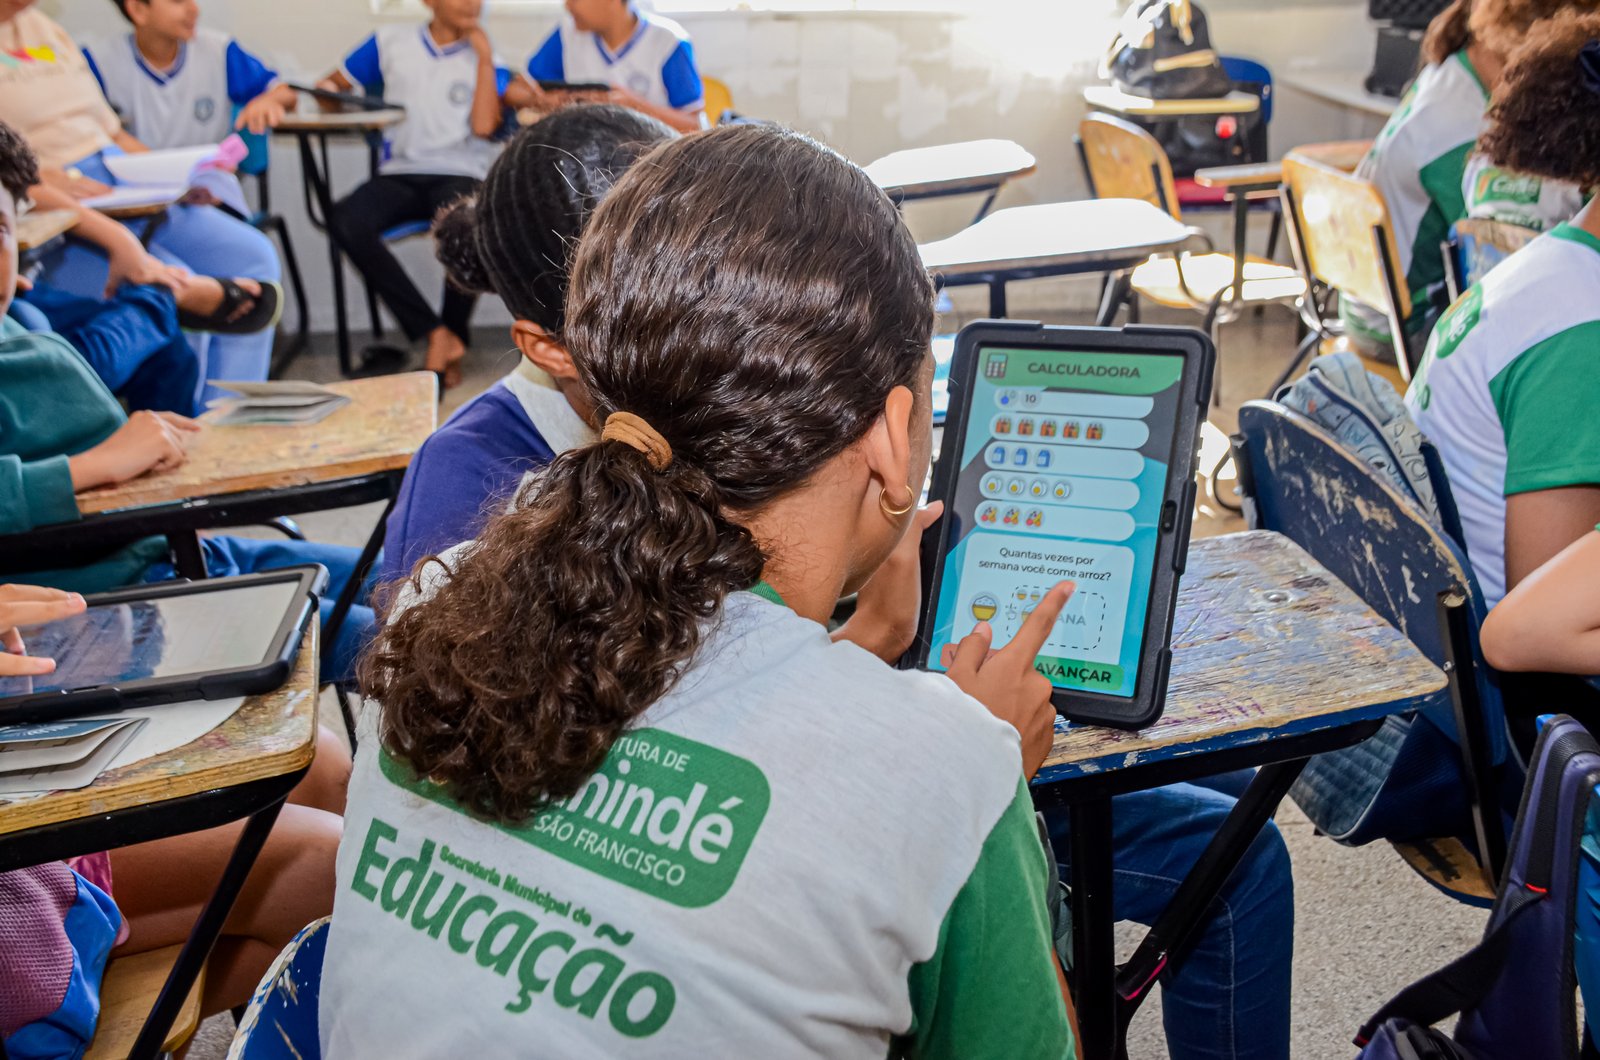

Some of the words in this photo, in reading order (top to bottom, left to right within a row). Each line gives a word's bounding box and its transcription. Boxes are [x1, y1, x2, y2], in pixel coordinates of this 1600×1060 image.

[1027, 362, 1141, 378] CALCULADORA
[999, 547, 1042, 560] Quantas
[1044, 554, 1074, 563] vezes
[1075, 556, 1095, 566] por
[978, 559, 1019, 571] semana
[1021, 564, 1045, 574] você
[1047, 567, 1077, 578] come
[1078, 571, 1112, 581] arroz?
[1035, 662, 1112, 684] AVANÇAR
[662, 750, 691, 772] DE
[560, 759, 744, 865] nindé
[534, 814, 575, 842] SÃO
[573, 828, 686, 887] FRANCISCO
[440, 845, 501, 888] Secretaria
[502, 873, 572, 918] Municipal
[572, 906, 592, 927] de
[350, 817, 677, 1038] Educação
